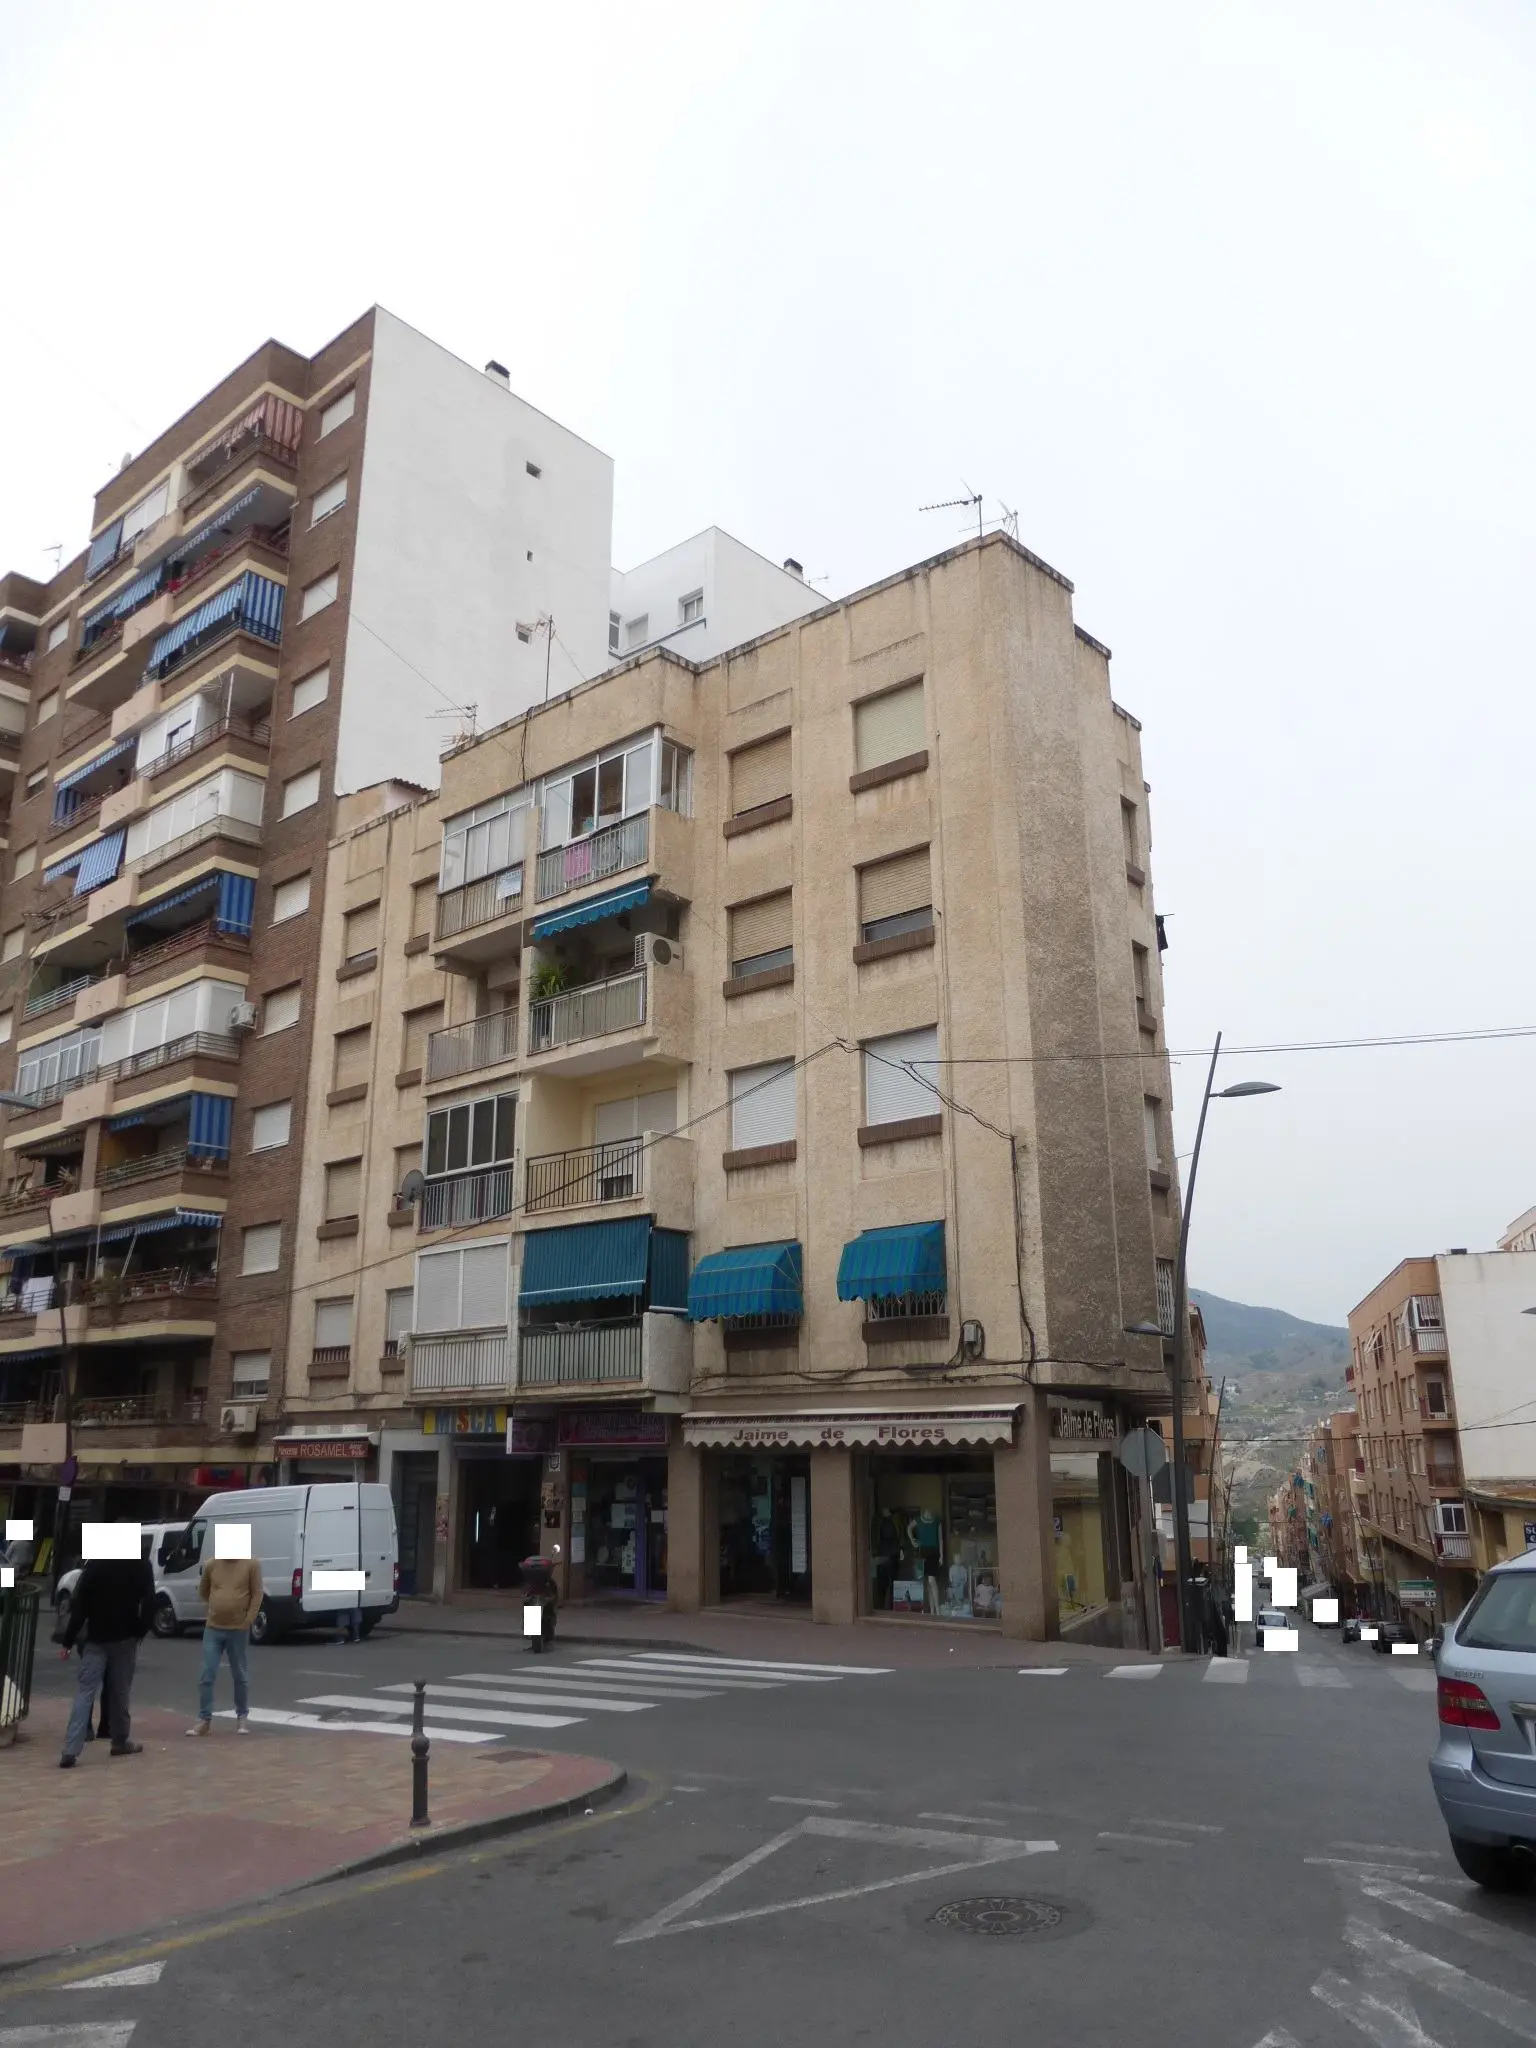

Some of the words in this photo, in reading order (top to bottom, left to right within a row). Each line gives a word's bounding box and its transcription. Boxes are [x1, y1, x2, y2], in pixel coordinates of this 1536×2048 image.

[1058, 1407, 1082, 1438] Jaime
[733, 1429, 789, 1441] Jaime
[820, 1427, 845, 1440] de
[878, 1426, 946, 1439] Flores
[300, 1443, 348, 1457] ROSAMEL
